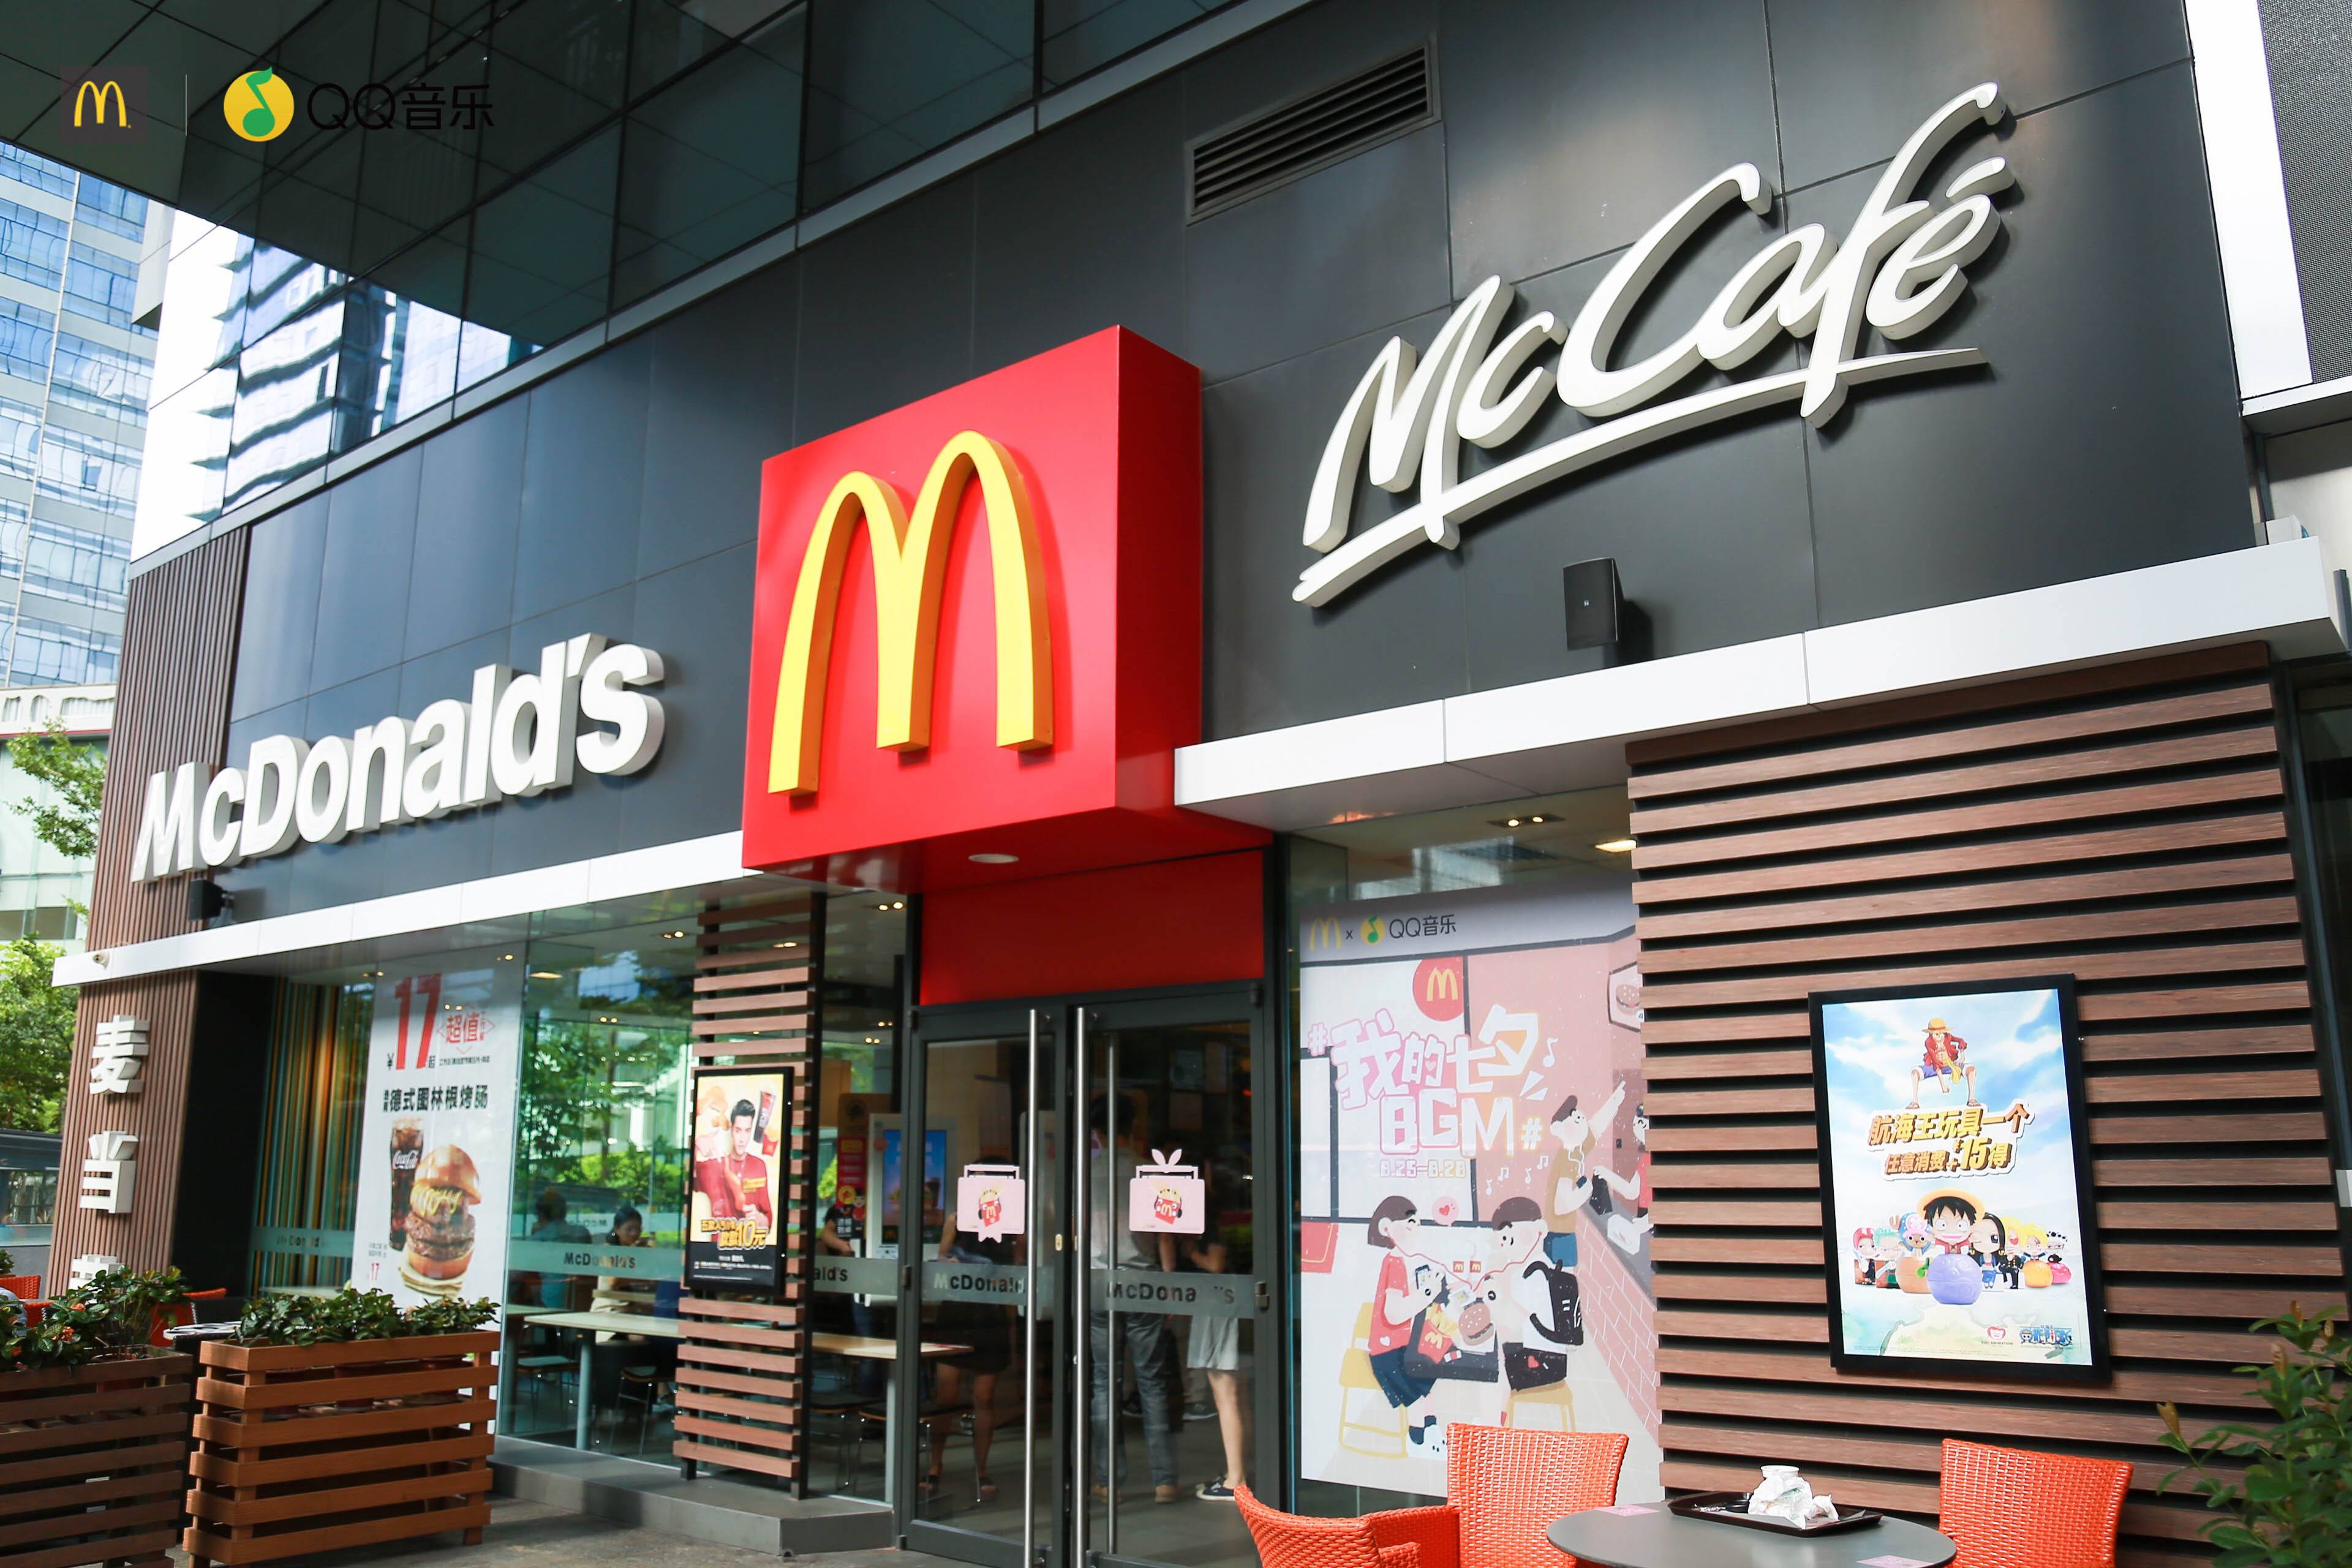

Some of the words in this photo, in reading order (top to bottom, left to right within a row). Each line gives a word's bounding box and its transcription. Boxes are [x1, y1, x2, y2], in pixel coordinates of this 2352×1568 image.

[1297, 81, 2016, 554] McCafé
[130, 632, 665, 883] McDonald's
[1389, 914, 1457, 939] QQ音乐
[1868, 1103, 2029, 1145] 航海王玩具一个
[933, 1272, 1026, 1294] McDonald
